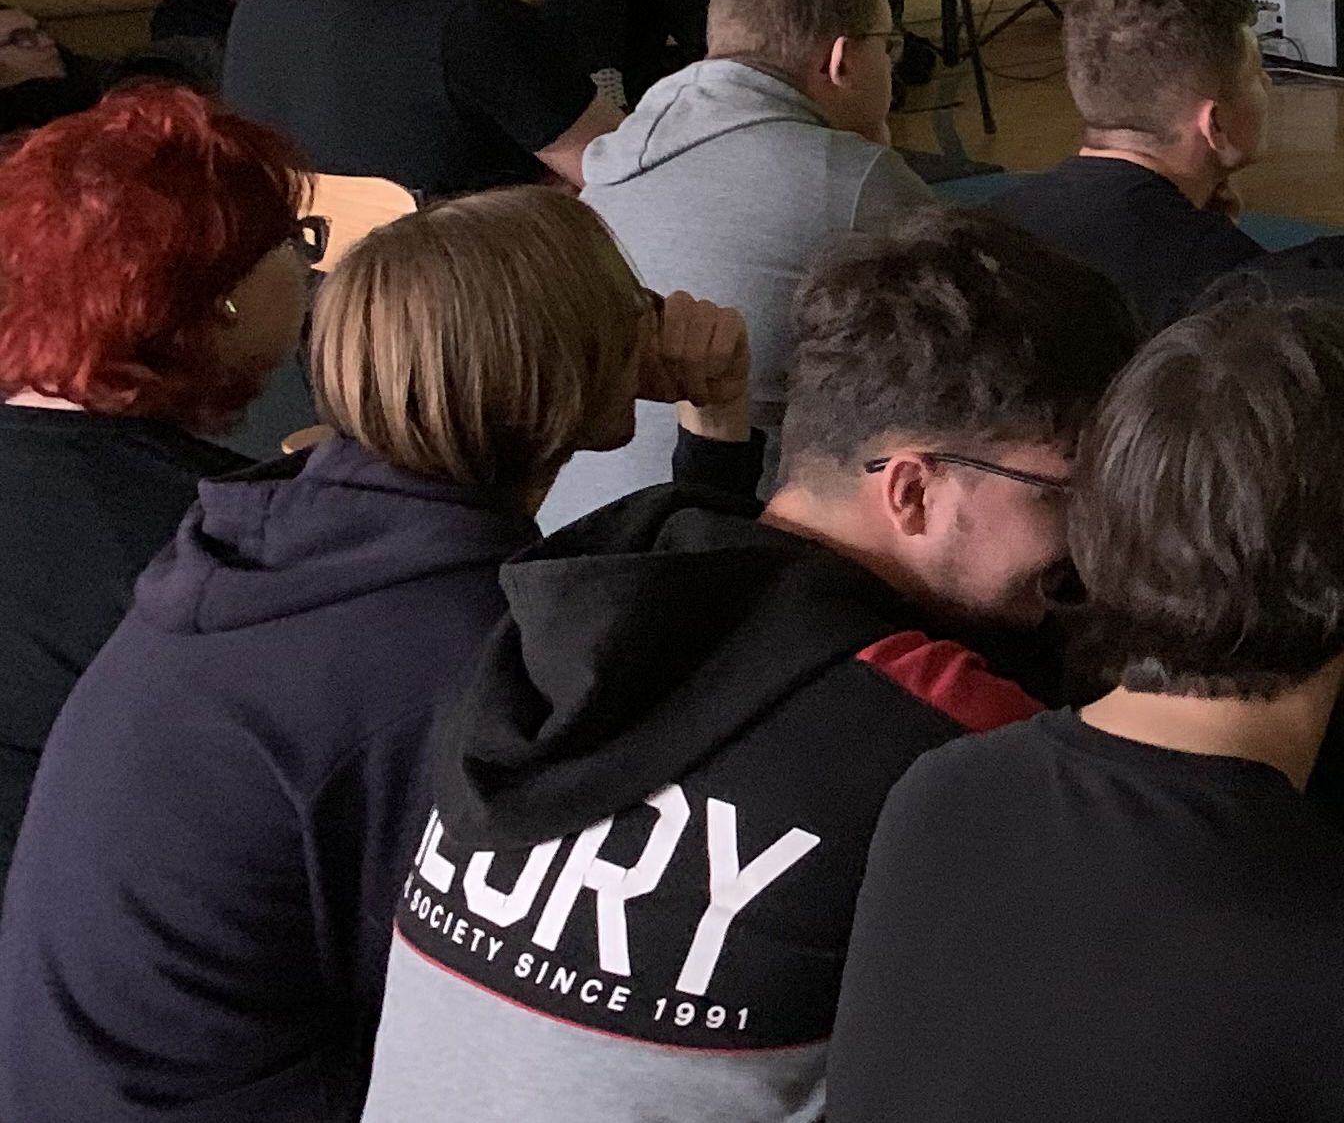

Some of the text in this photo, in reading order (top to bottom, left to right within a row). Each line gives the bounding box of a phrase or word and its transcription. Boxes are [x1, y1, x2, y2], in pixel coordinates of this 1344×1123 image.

[409, 887, 750, 1031] SOCIETY SINCE 1991
